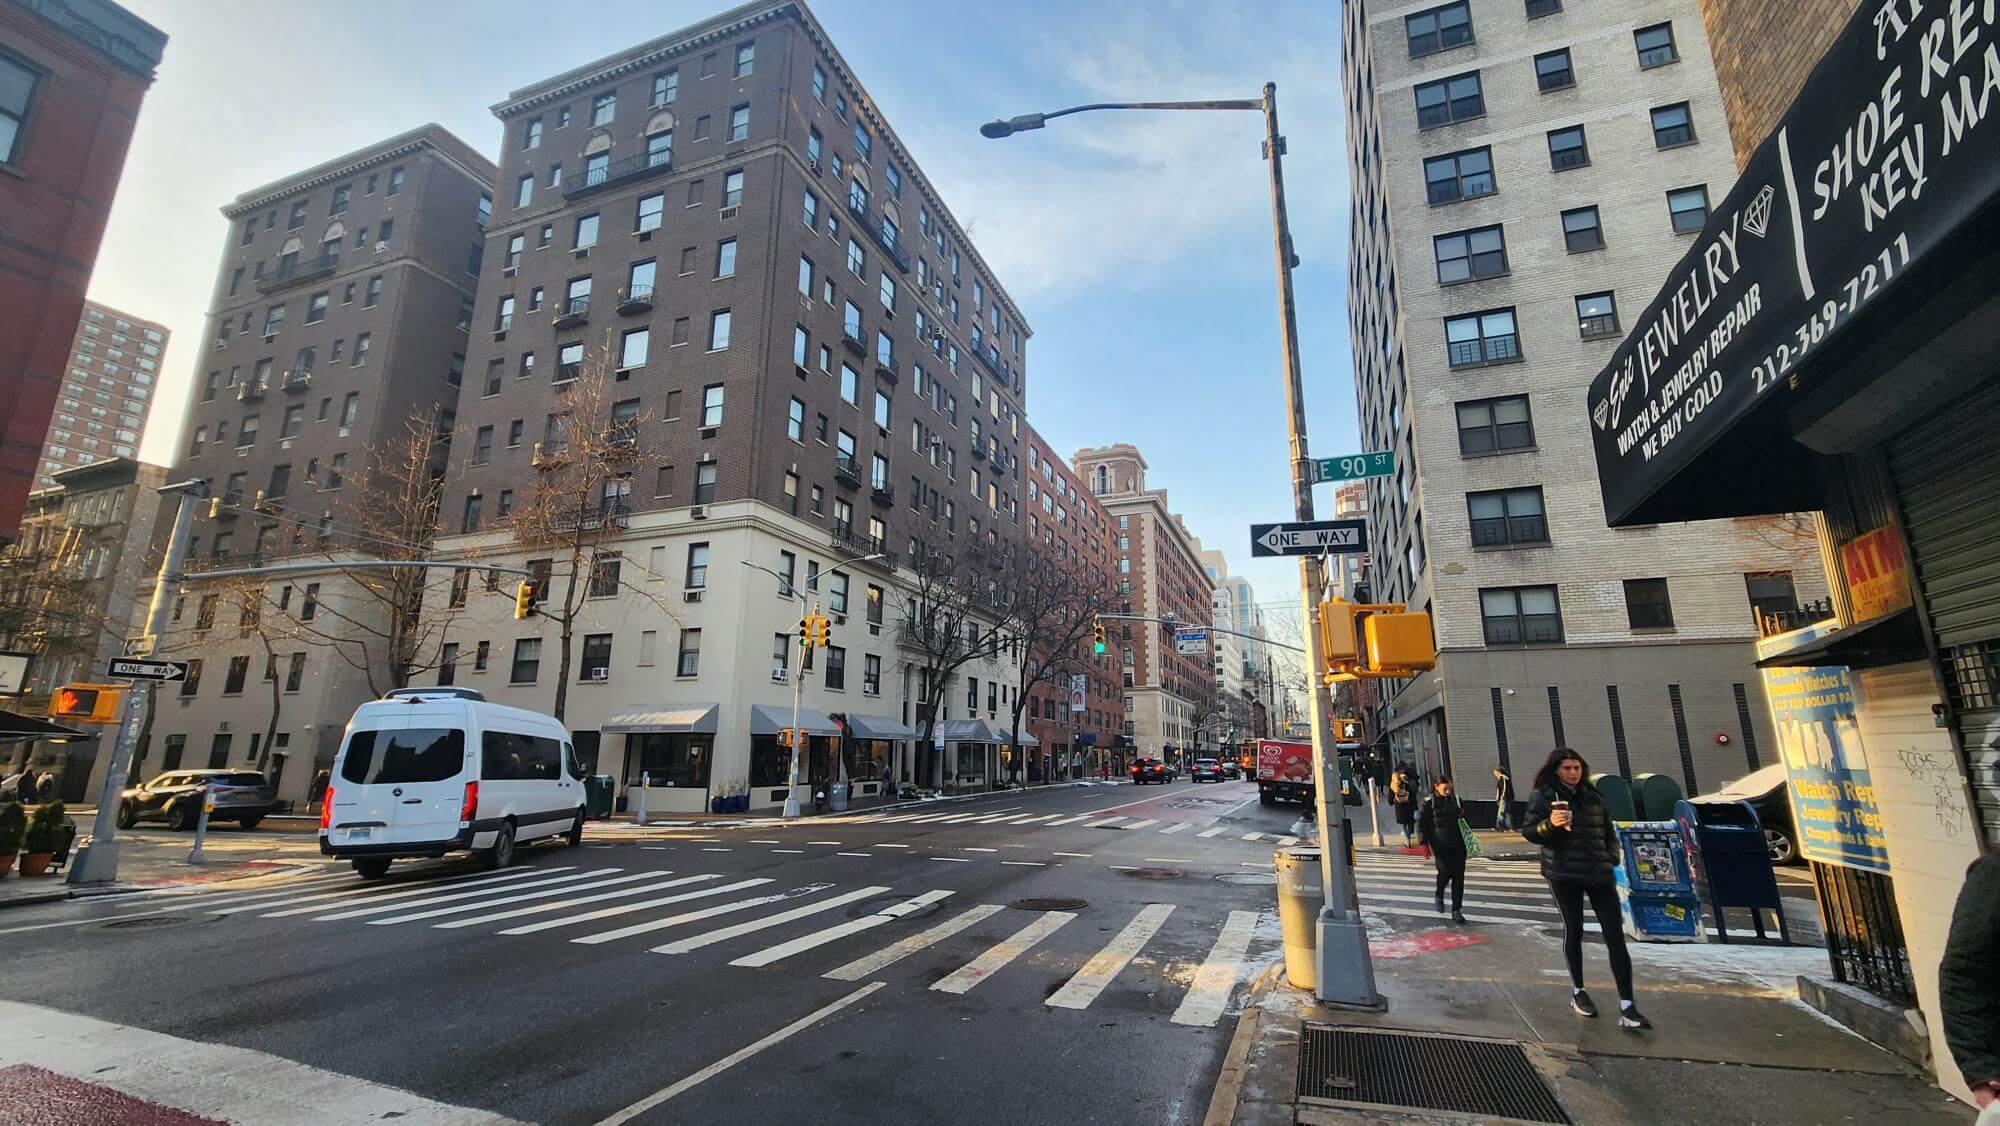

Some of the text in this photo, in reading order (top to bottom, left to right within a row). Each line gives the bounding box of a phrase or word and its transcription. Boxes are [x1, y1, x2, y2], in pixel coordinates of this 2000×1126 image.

[1813, 0, 1996, 221] SHOE RE
[1860, 123, 1928, 232] KEY
[1637, 210, 1741, 398] JEWELRY
[1751, 232, 1911, 395] 212-369-7211
[1616, 282, 1762, 457] WATCH & JEWELRY REPAIR
[1642, 433, 1659, 463] WE
[1661, 413, 1682, 451] BUY
[1320, 454, 1387, 481] E 90 ST
[1268, 530, 1351, 547] ONE WAY
[1843, 526, 1906, 588] ATM
[120, 664, 177, 675] ONE WAY
[1804, 673, 1840, 692] Watches
[1788, 698, 1804, 710] TOP
[1805, 693, 1838, 707] DOLLAR
[1794, 778, 1841, 800] Watch
